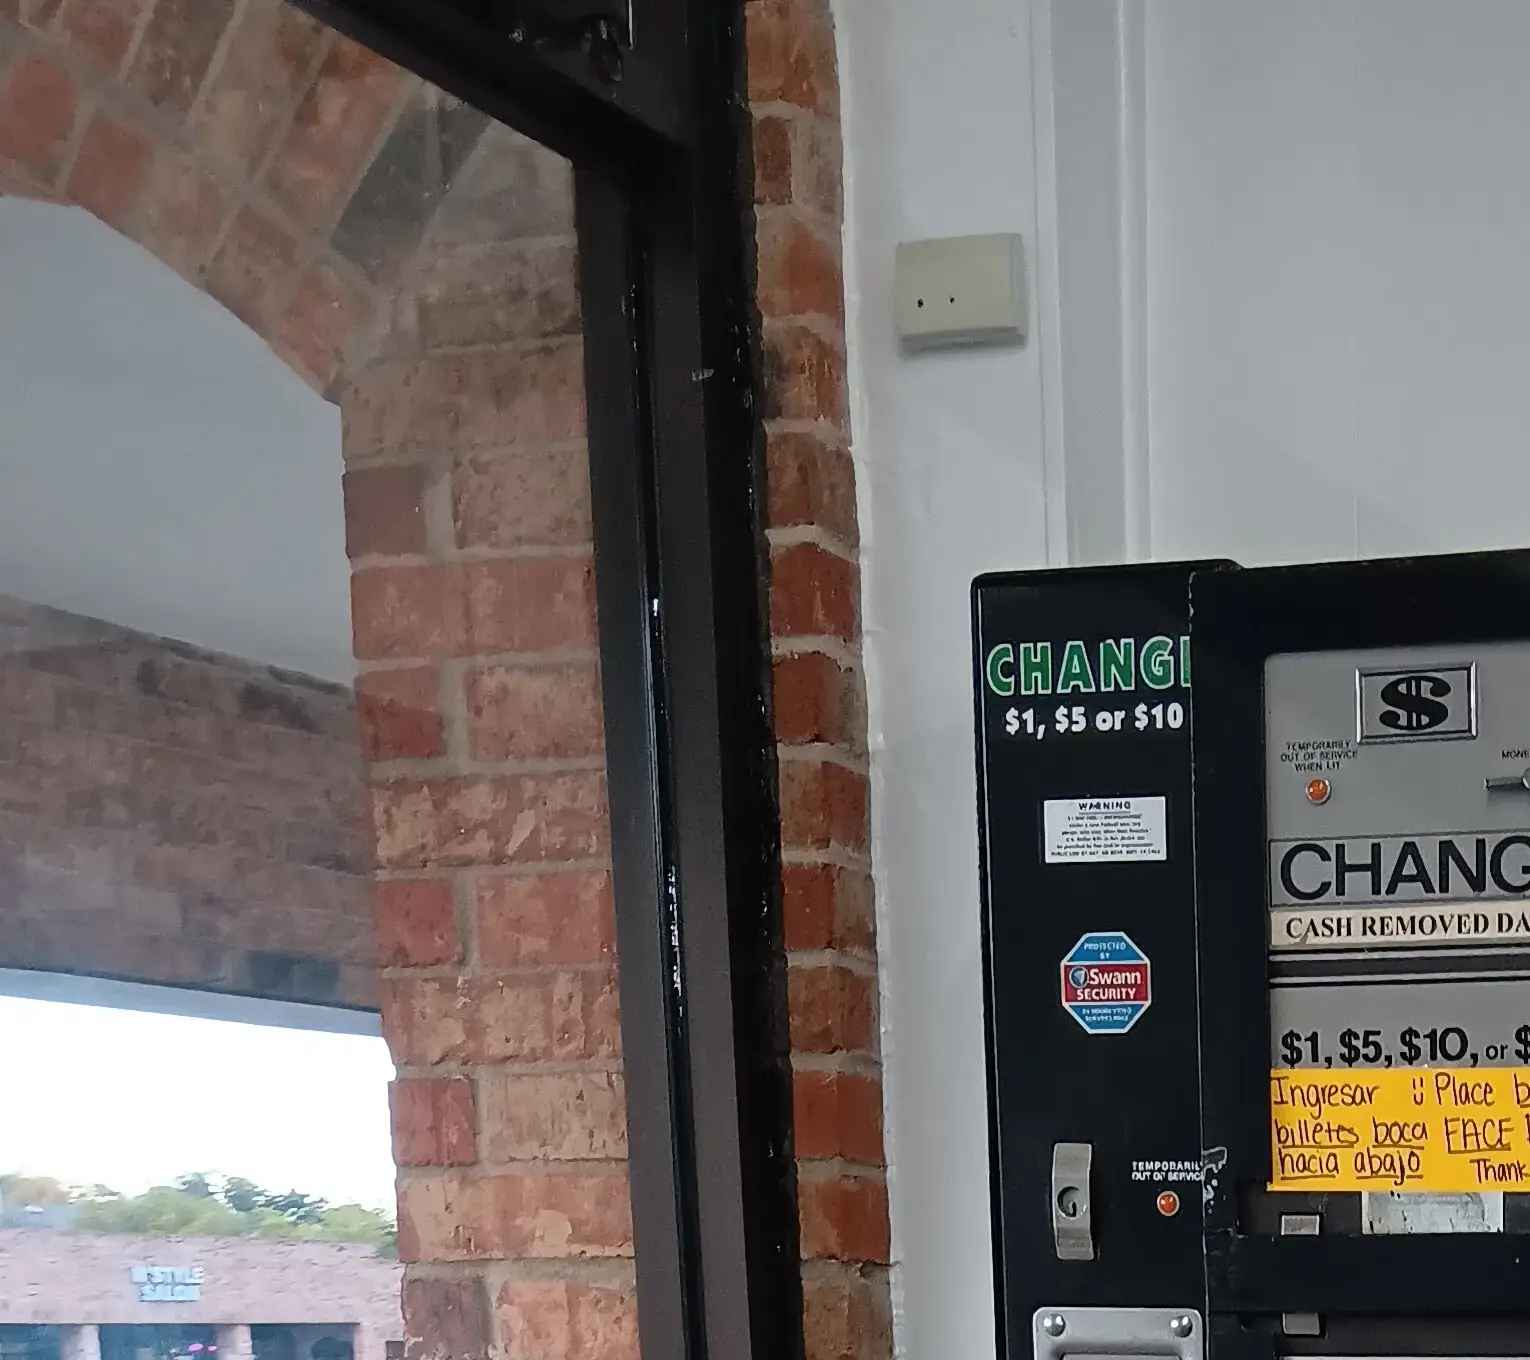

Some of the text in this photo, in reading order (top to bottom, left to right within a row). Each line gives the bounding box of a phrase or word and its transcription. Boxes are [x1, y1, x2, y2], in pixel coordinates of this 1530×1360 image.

[1005, 702, 1184, 740] $1, $5 or $10
[1078, 801, 1131, 810] WARNING
[1285, 916, 1352, 940] CASH
[1361, 914, 1490, 938] REMOVED
[1089, 968, 1142, 985] Swann
[1076, 987, 1136, 1001] SECURITY
[1281, 1030, 1333, 1069] $1,
[1339, 1028, 1393, 1069] $5,
[1400, 1027, 1479, 1068] $10,
[1485, 1044, 1509, 1061] or
[1271, 1076, 1380, 1120] Ingresar
[1434, 1072, 1496, 1107] Place
[1372, 1116, 1428, 1145] boca
[1444, 1116, 1514, 1150] FACE
[1131, 1171, 1151, 1181] OUT
[1278, 1145, 1421, 1186] hacia abajo
[1469, 1158, 1530, 1183] Thank
